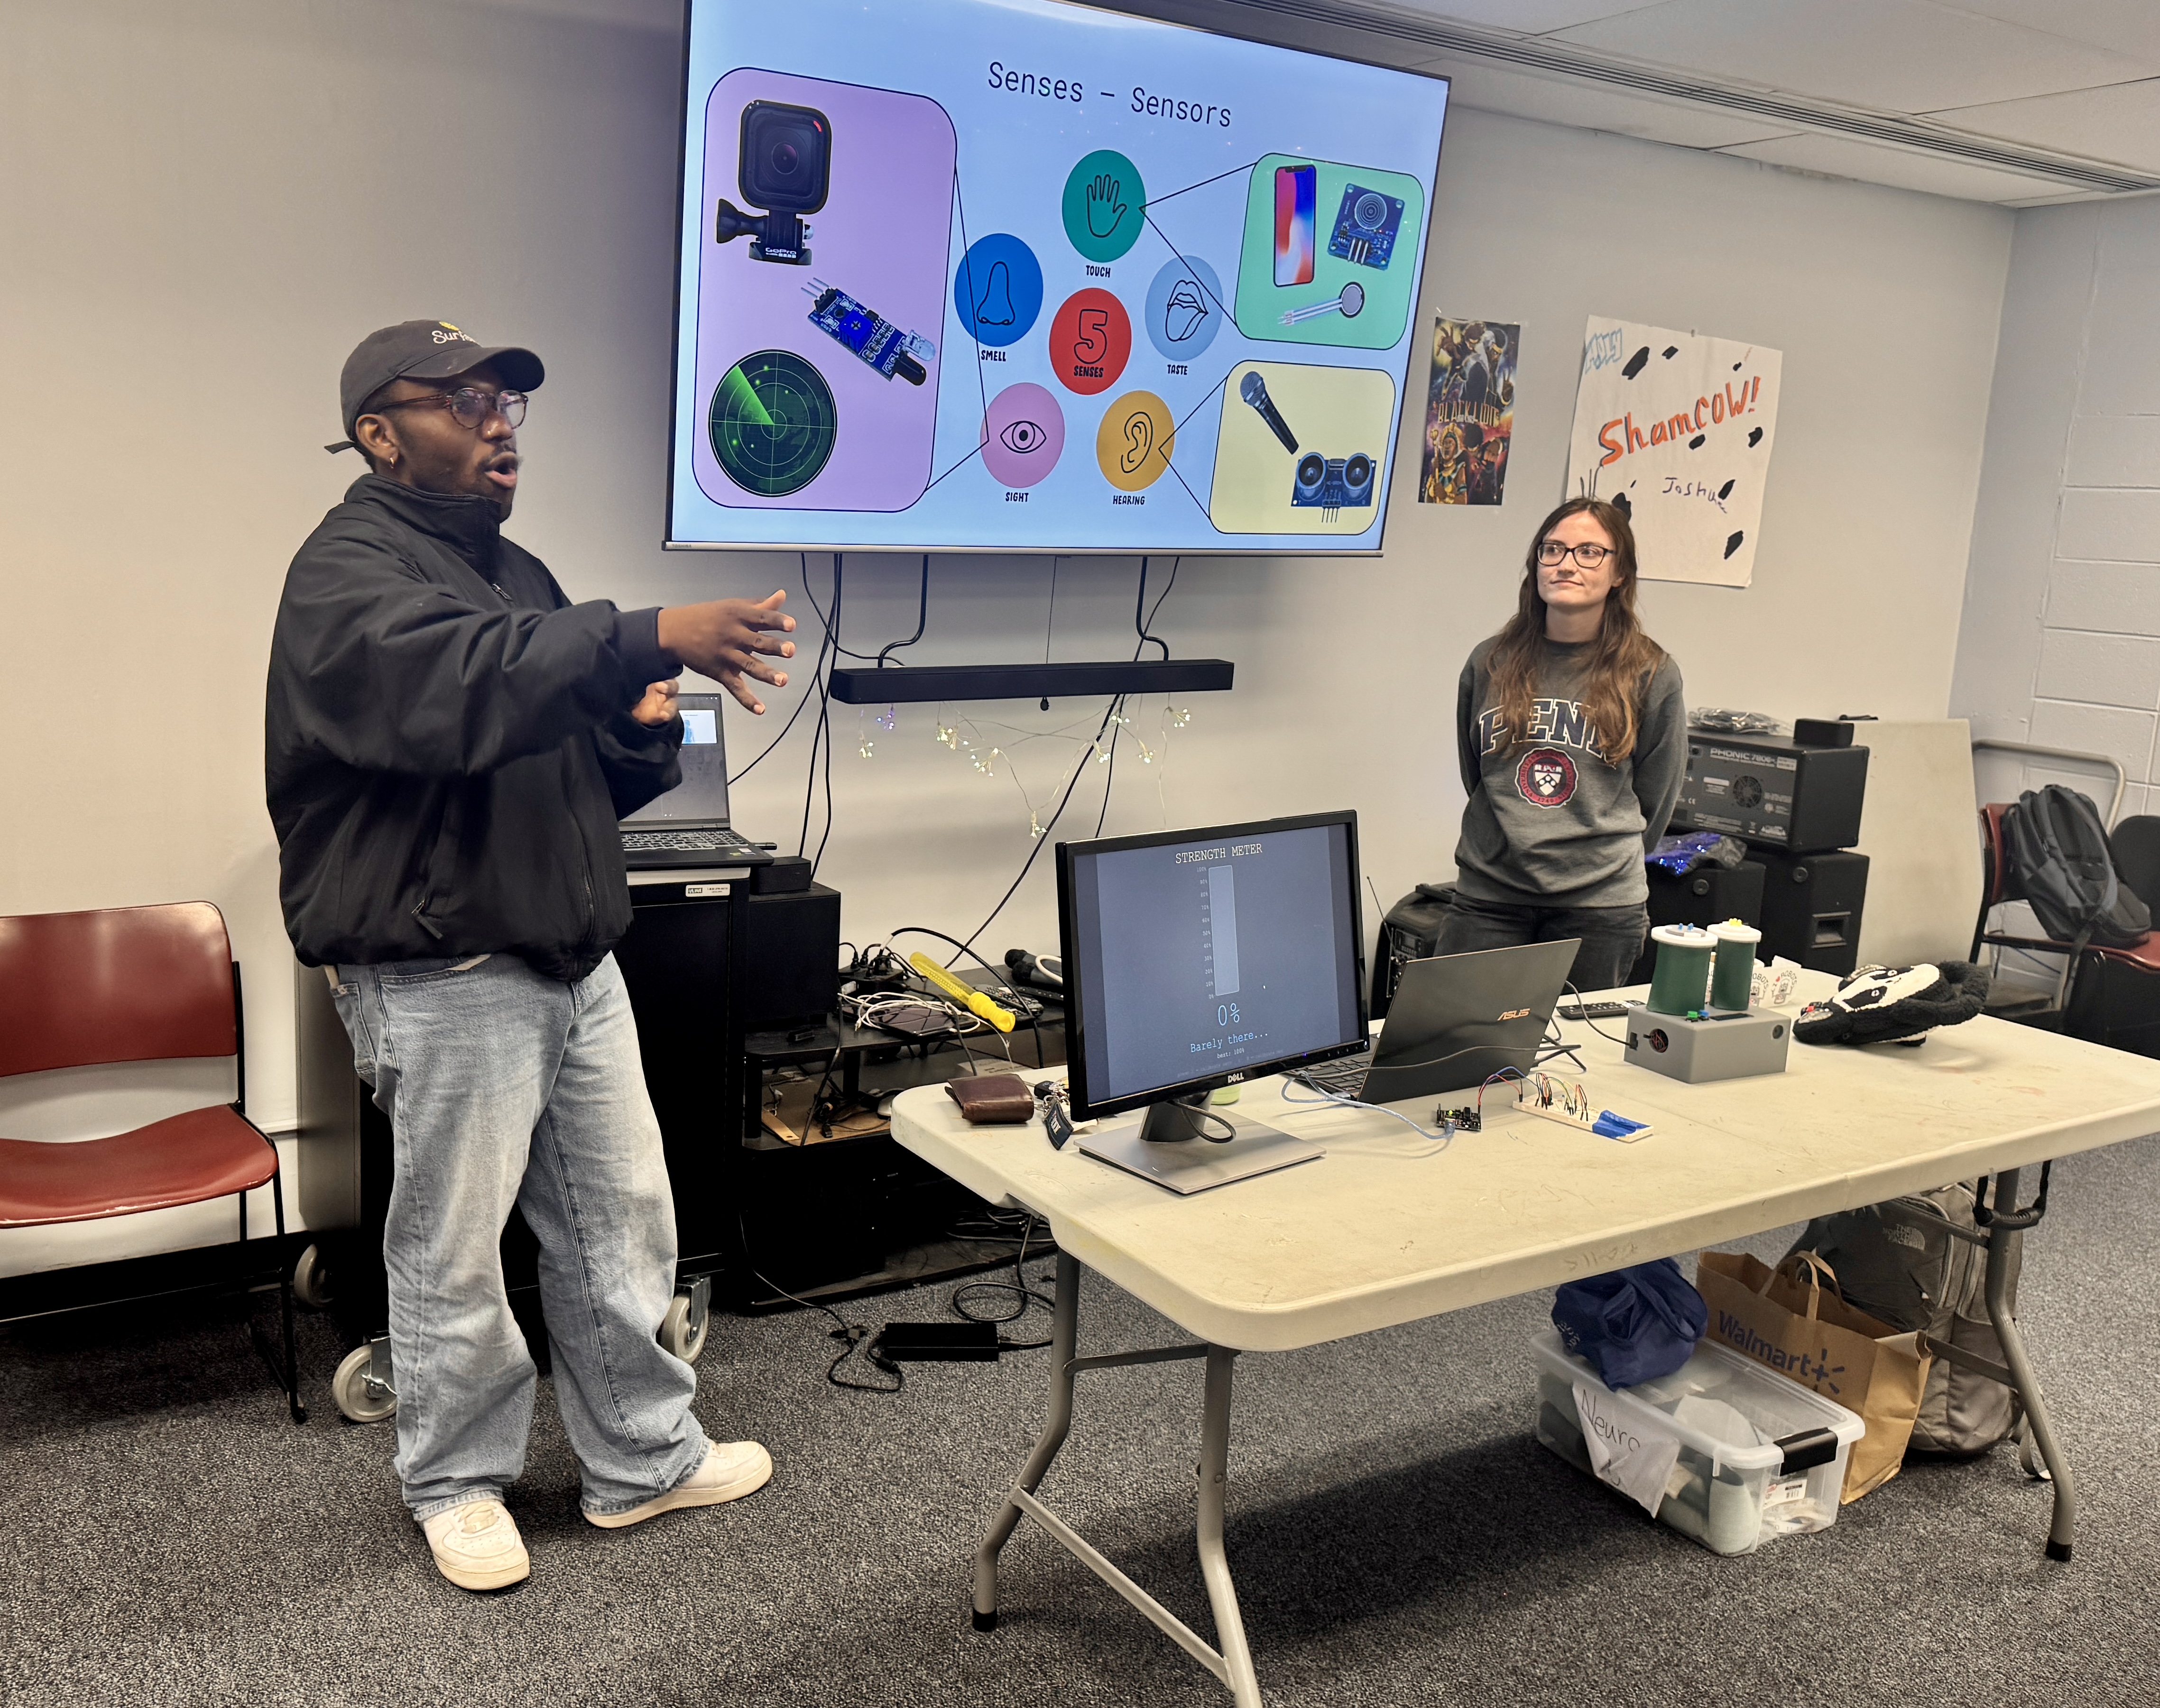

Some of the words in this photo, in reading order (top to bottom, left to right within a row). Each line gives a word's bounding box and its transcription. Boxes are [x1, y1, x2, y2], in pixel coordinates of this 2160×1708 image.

[988, 62, 1083, 102] Senses
[1131, 87, 1231, 127] Sensors
[765, 247, 797, 255] GoPro
[1086, 265, 1111, 278] TOUCH
[1073, 309, 1108, 364] 5
[981, 350, 1006, 362] SMELL
[1073, 365, 1104, 378] SENSES
[1167, 364, 1188, 376] TASTE
[1438, 401, 1471, 423] BLACK
[1005, 491, 1029, 503] SIGHT
[1113, 495, 1145, 505] HEARING
[1710, 748, 1750, 760] PHONIC
[1175, 847, 1226, 864] STRENGTH
[1232, 843, 1263, 858] METER
[1751, 973, 1769, 990] OBOTS
[1781, 970, 1797, 986] ROBOTS
[1218, 1002, 1240, 1026] 0%
[1497, 1008, 1530, 1021] ASUS
[1190, 1038, 1222, 1053] Barely
[1228, 1032, 1268, 1044] there...
[1228, 1073, 1244, 1084] DELL
